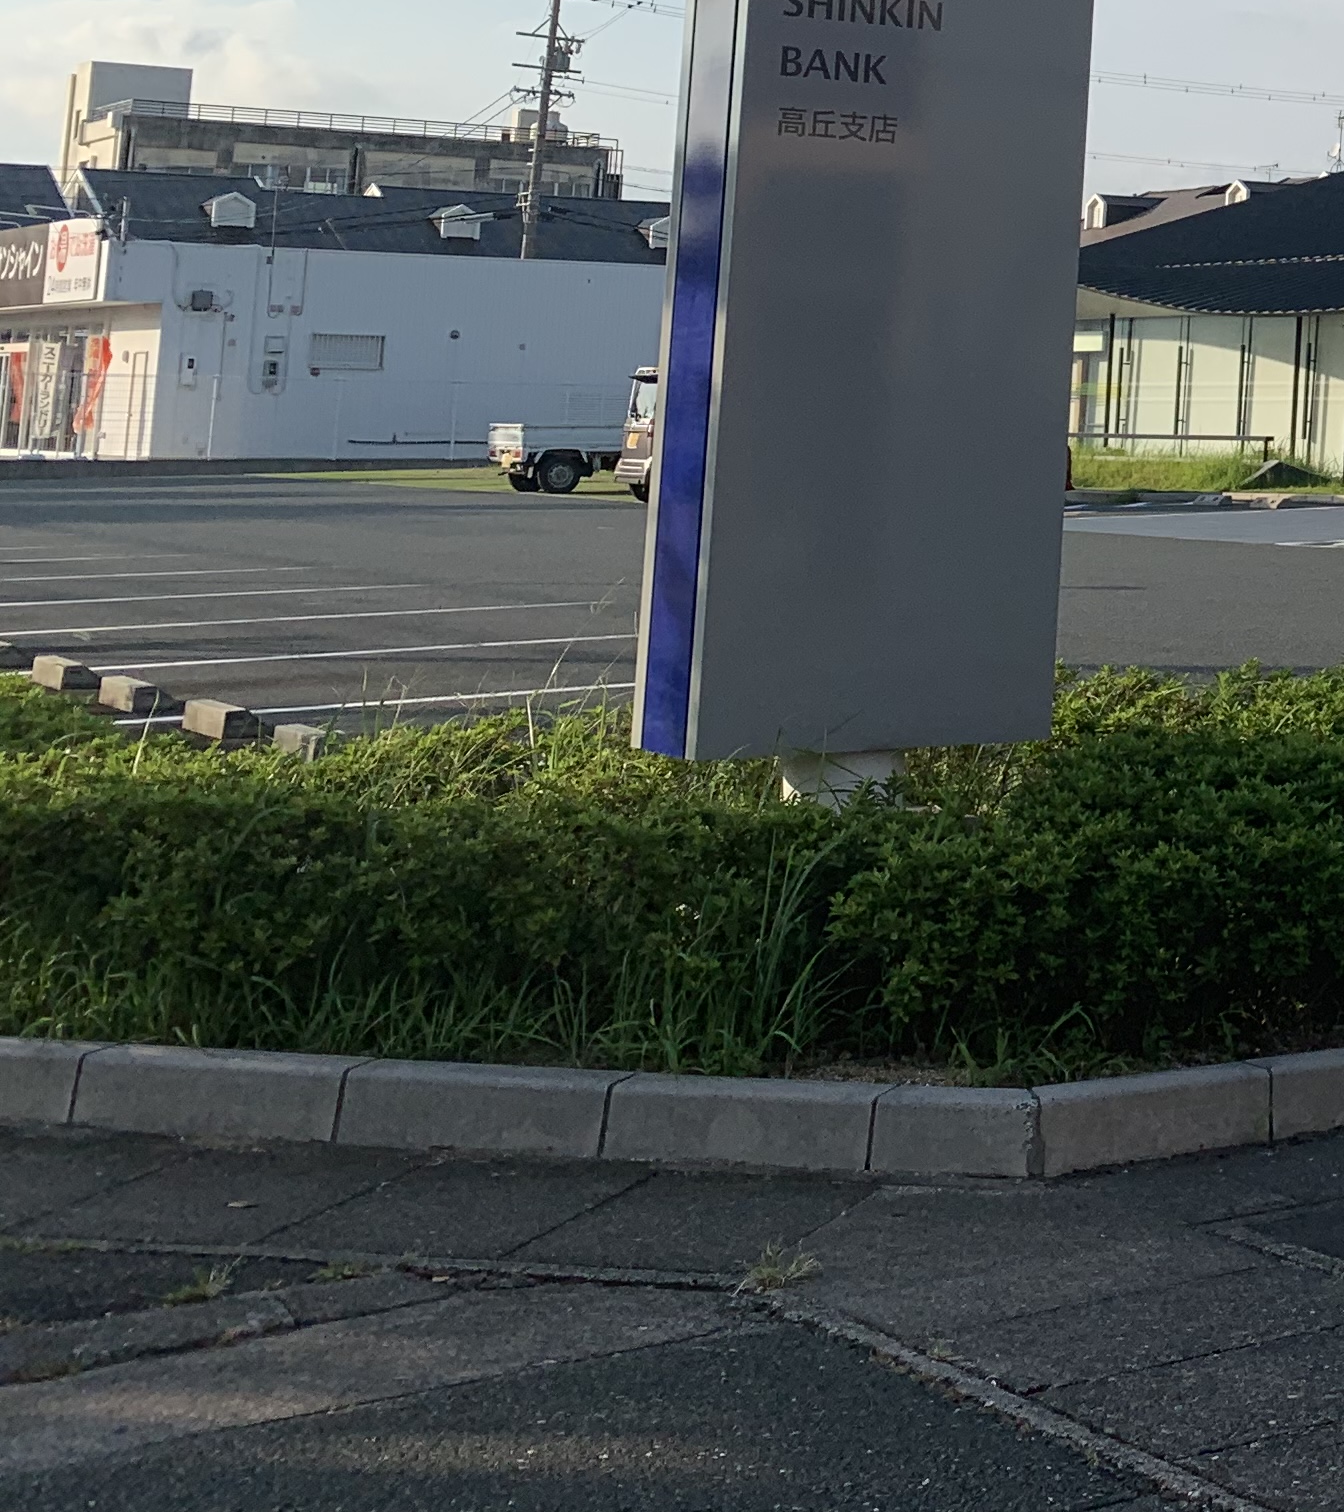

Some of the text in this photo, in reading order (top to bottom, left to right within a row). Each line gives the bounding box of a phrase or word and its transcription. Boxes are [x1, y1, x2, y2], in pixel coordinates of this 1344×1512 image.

[780, 45, 887, 85] BANK
[777, 107, 898, 144] 高丘支店
